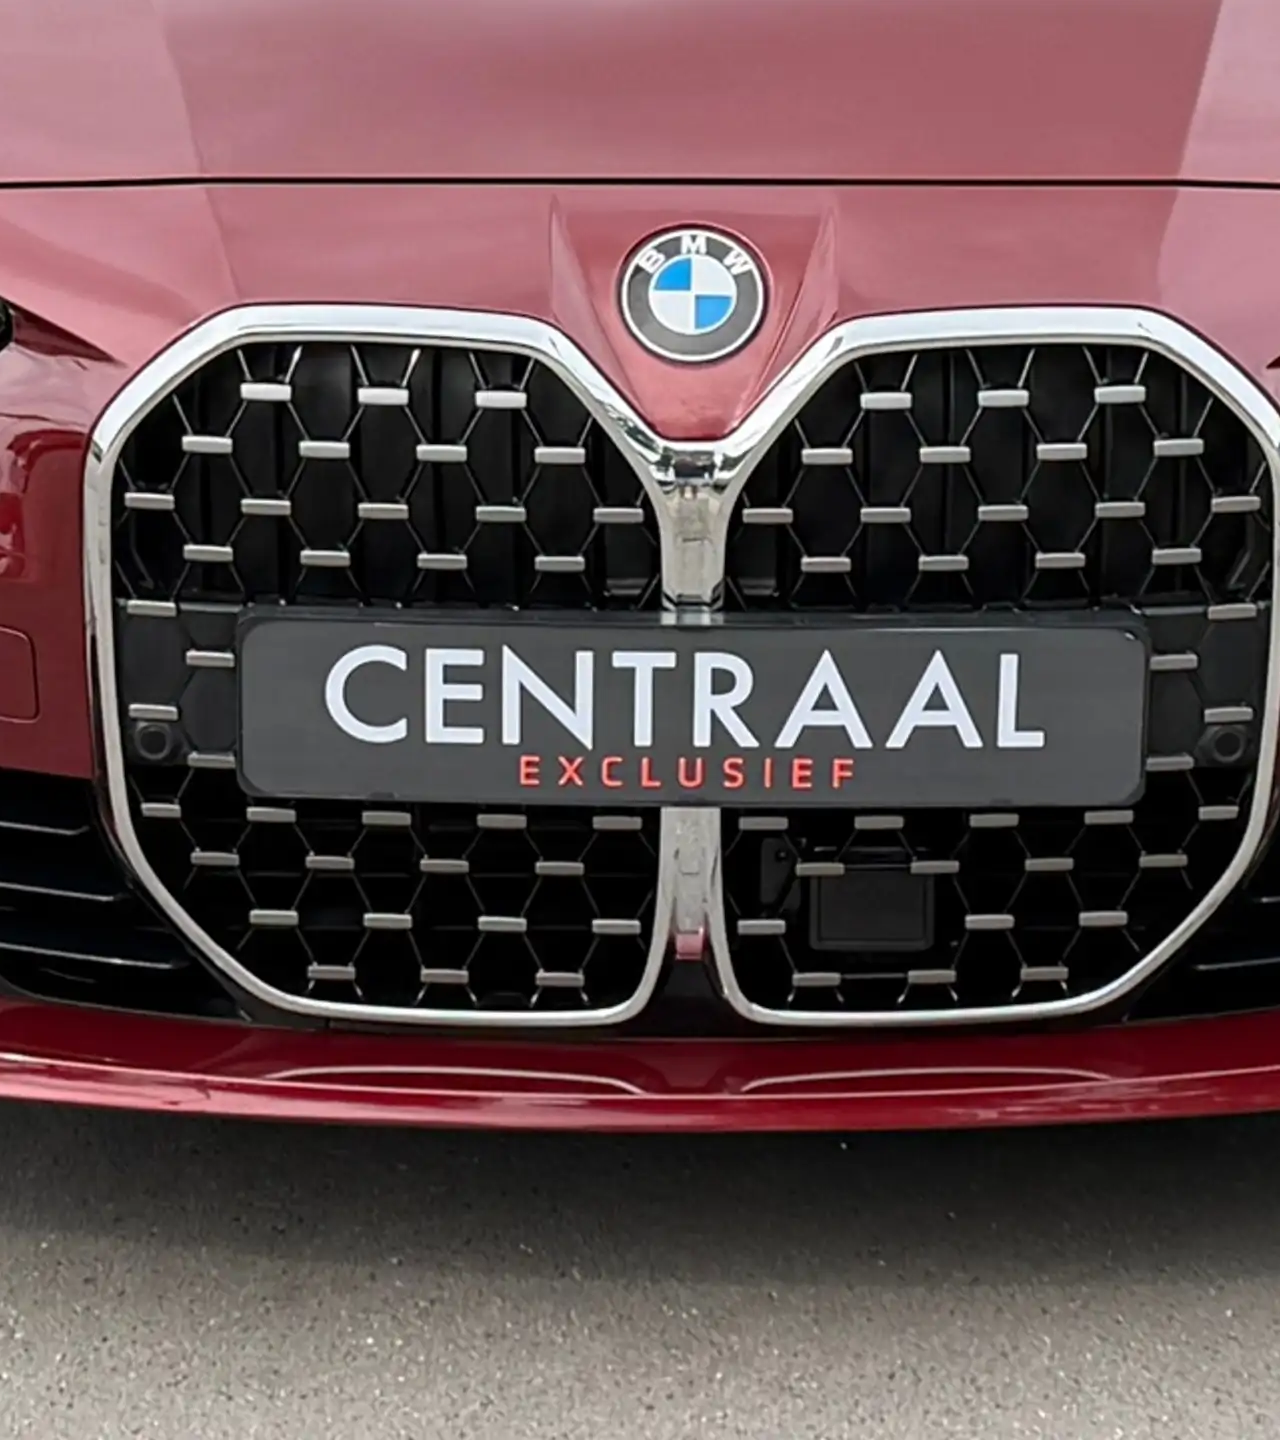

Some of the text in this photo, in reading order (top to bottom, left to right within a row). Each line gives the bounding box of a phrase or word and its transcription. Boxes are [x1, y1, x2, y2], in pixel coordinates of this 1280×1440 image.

[637, 234, 753, 276] BMW
[324, 644, 1045, 750] CENTRAAL
[519, 755, 855, 790] EXCLUSIEF
